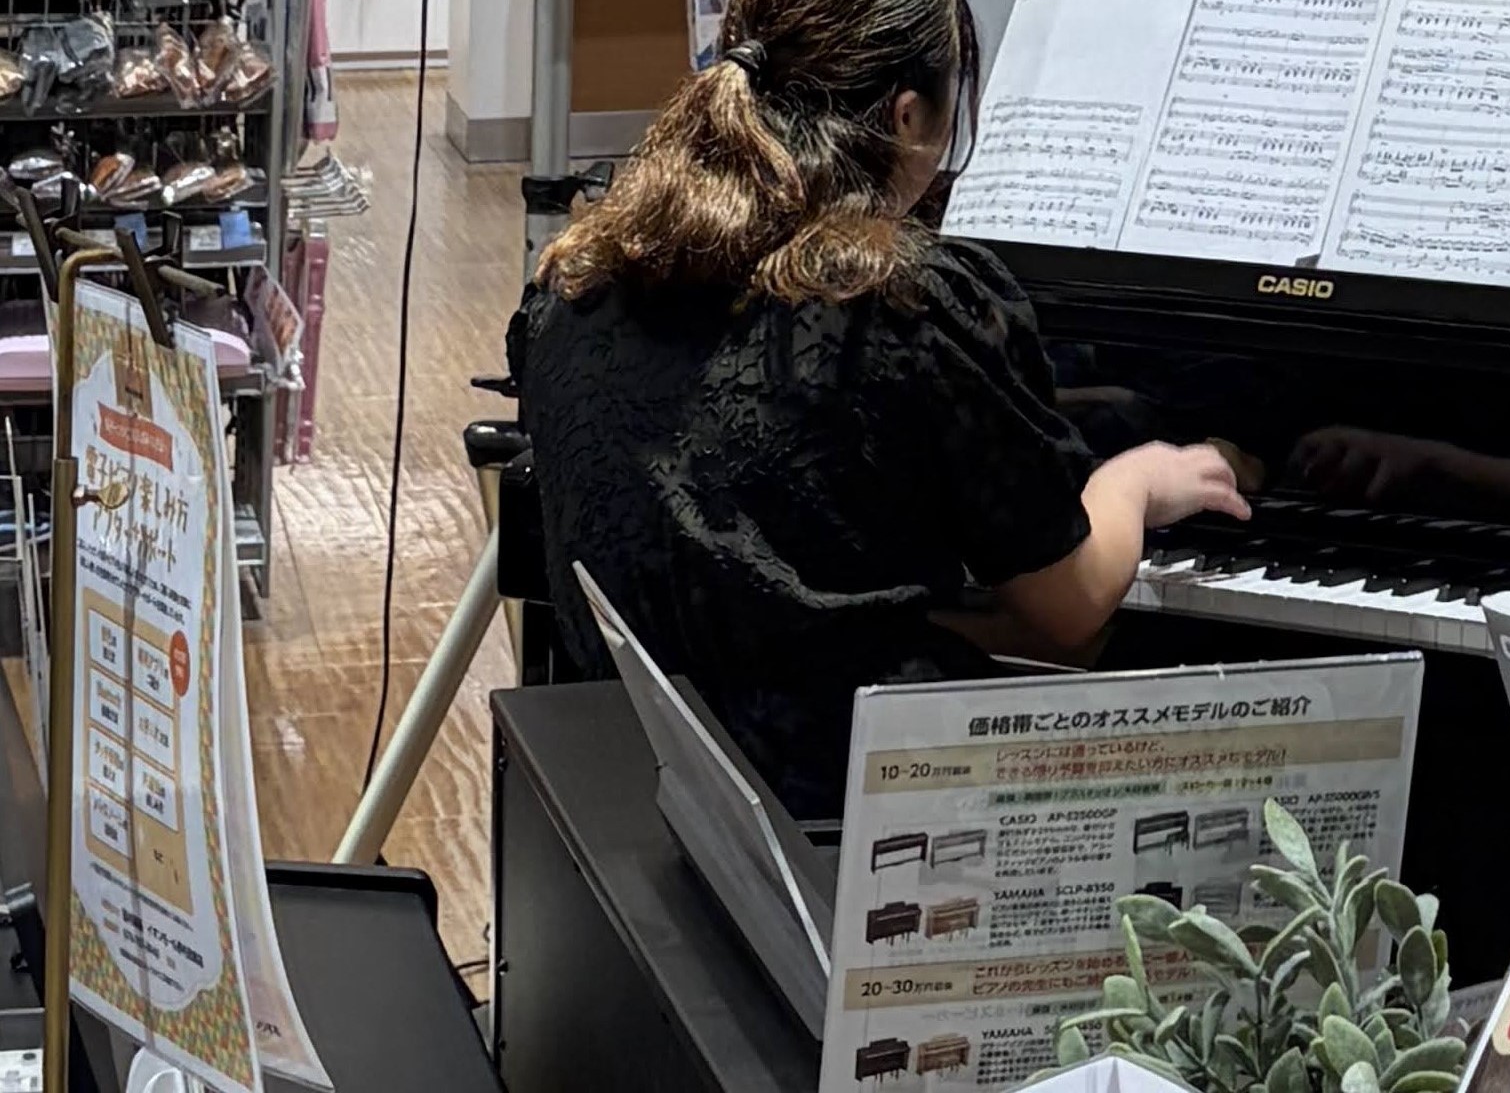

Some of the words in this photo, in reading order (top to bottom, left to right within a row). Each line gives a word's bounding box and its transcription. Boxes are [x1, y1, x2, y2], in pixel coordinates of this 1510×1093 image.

[1257, 275, 1334, 299] CASIO
[968, 696, 1311, 737] 価格帯ごとのオススメモデルのご紹介
[981, 1026, 1033, 1040] YAMAHA
